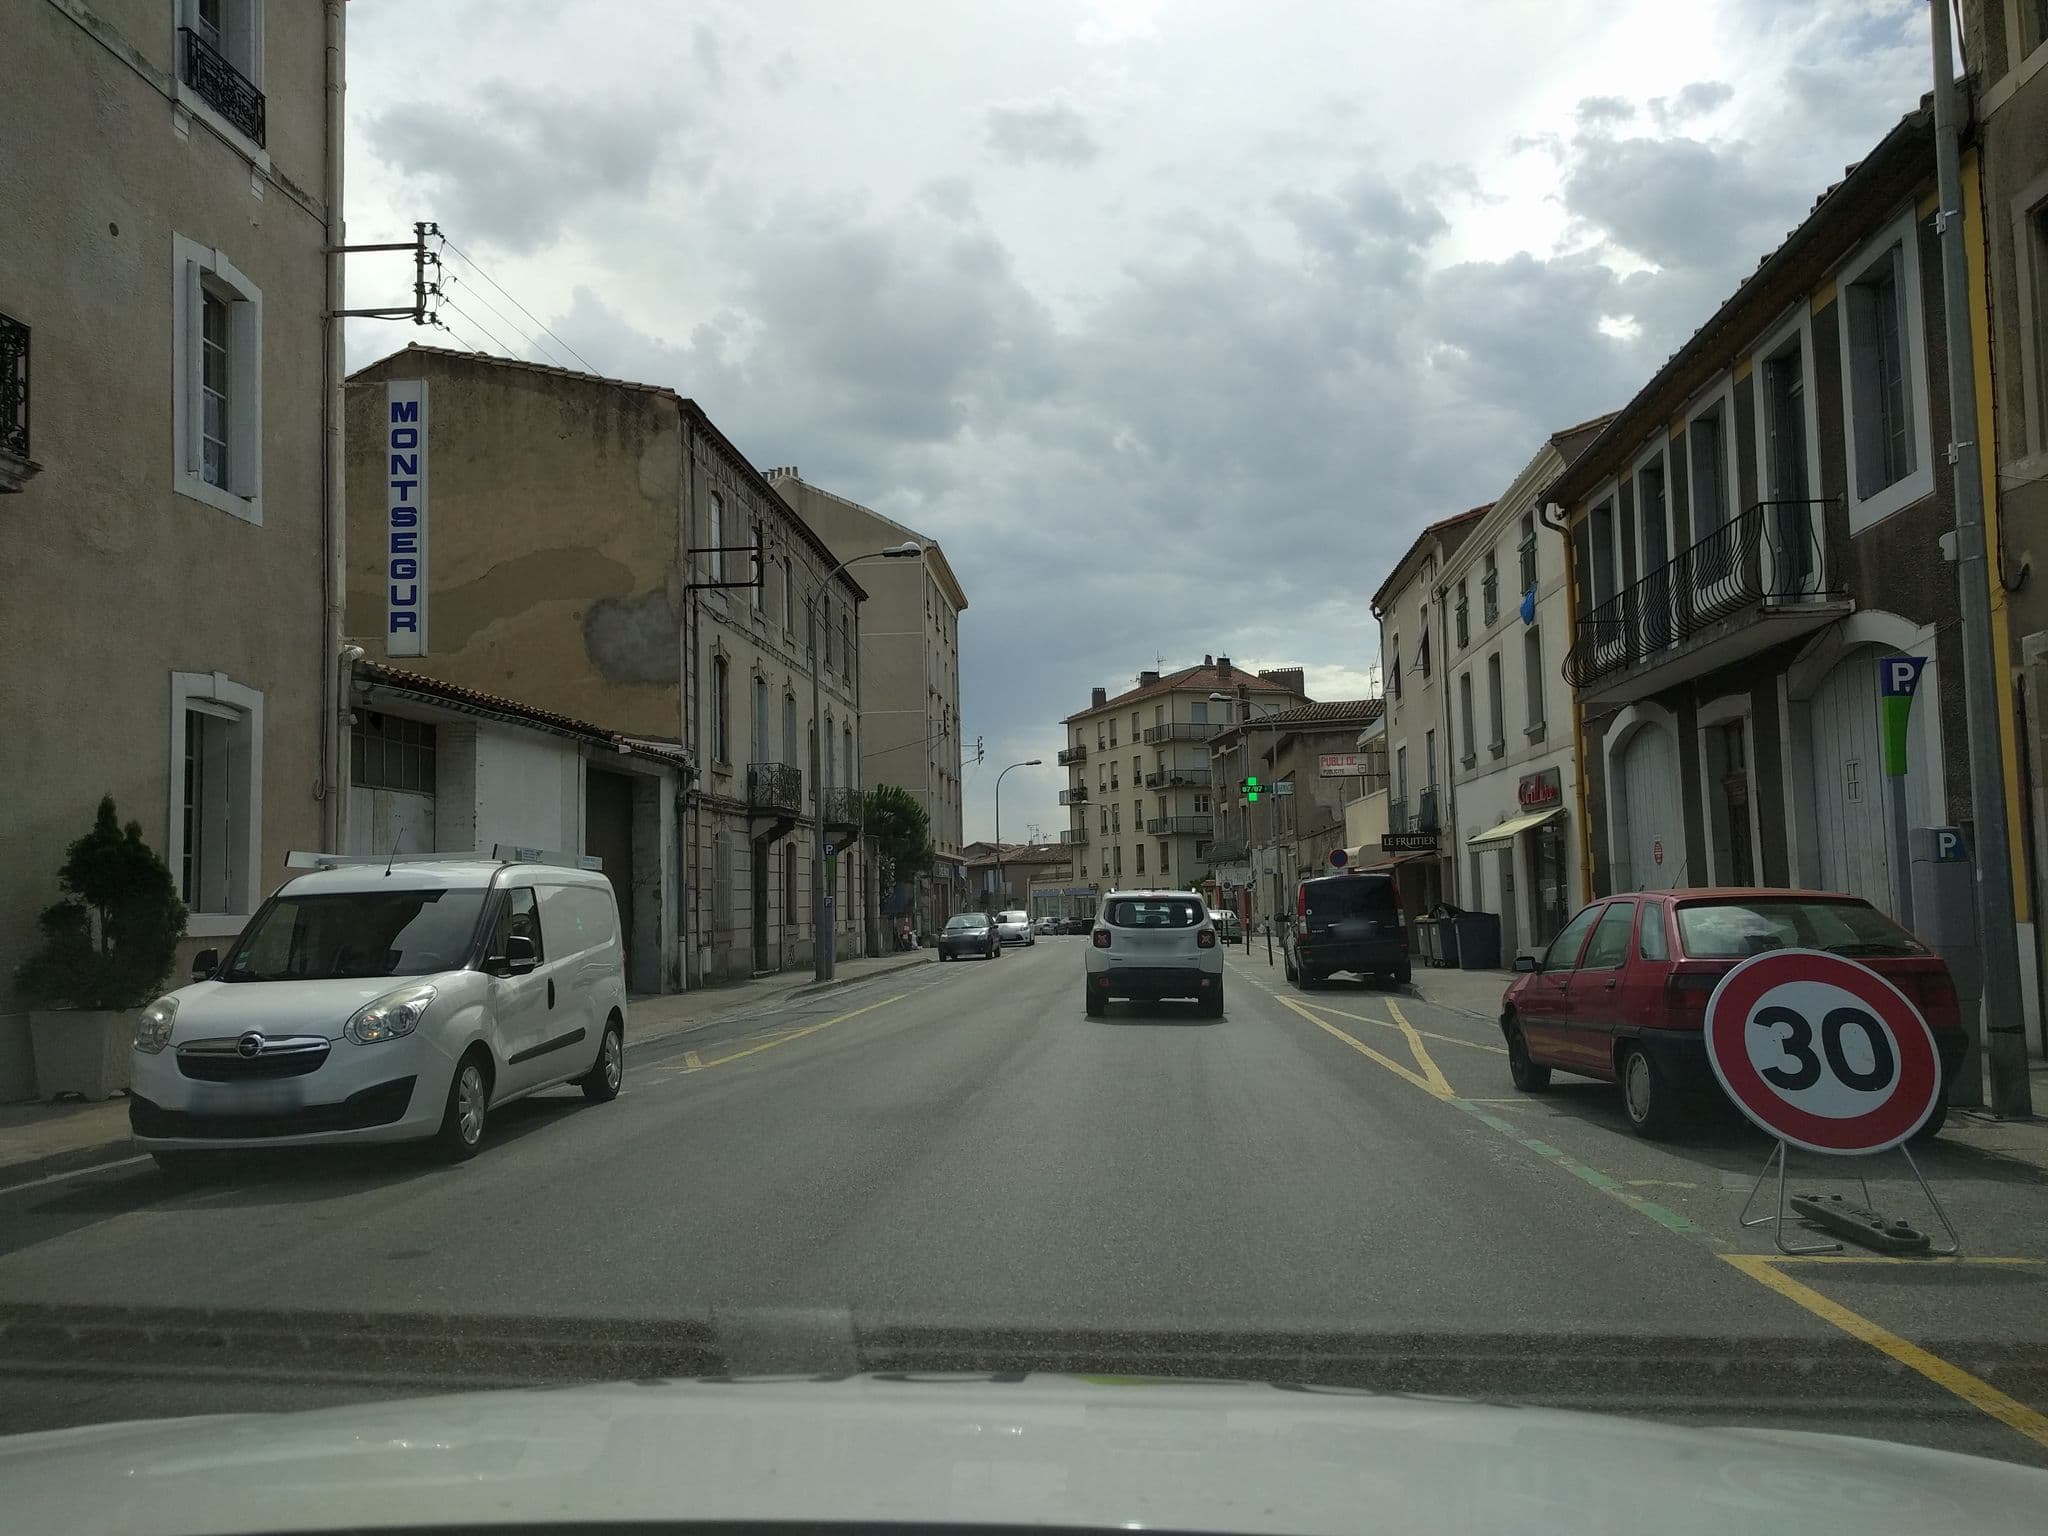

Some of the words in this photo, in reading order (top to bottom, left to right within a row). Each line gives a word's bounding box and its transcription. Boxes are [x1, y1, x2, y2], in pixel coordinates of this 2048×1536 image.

[390, 401, 418, 633] MONTSEGUR
[1891, 662, 1915, 692] P
[825, 844, 834, 855] P
[1383, 837, 1394, 846] LE
[1938, 832, 1957, 858] P
[1752, 1006, 1895, 1092] 30
